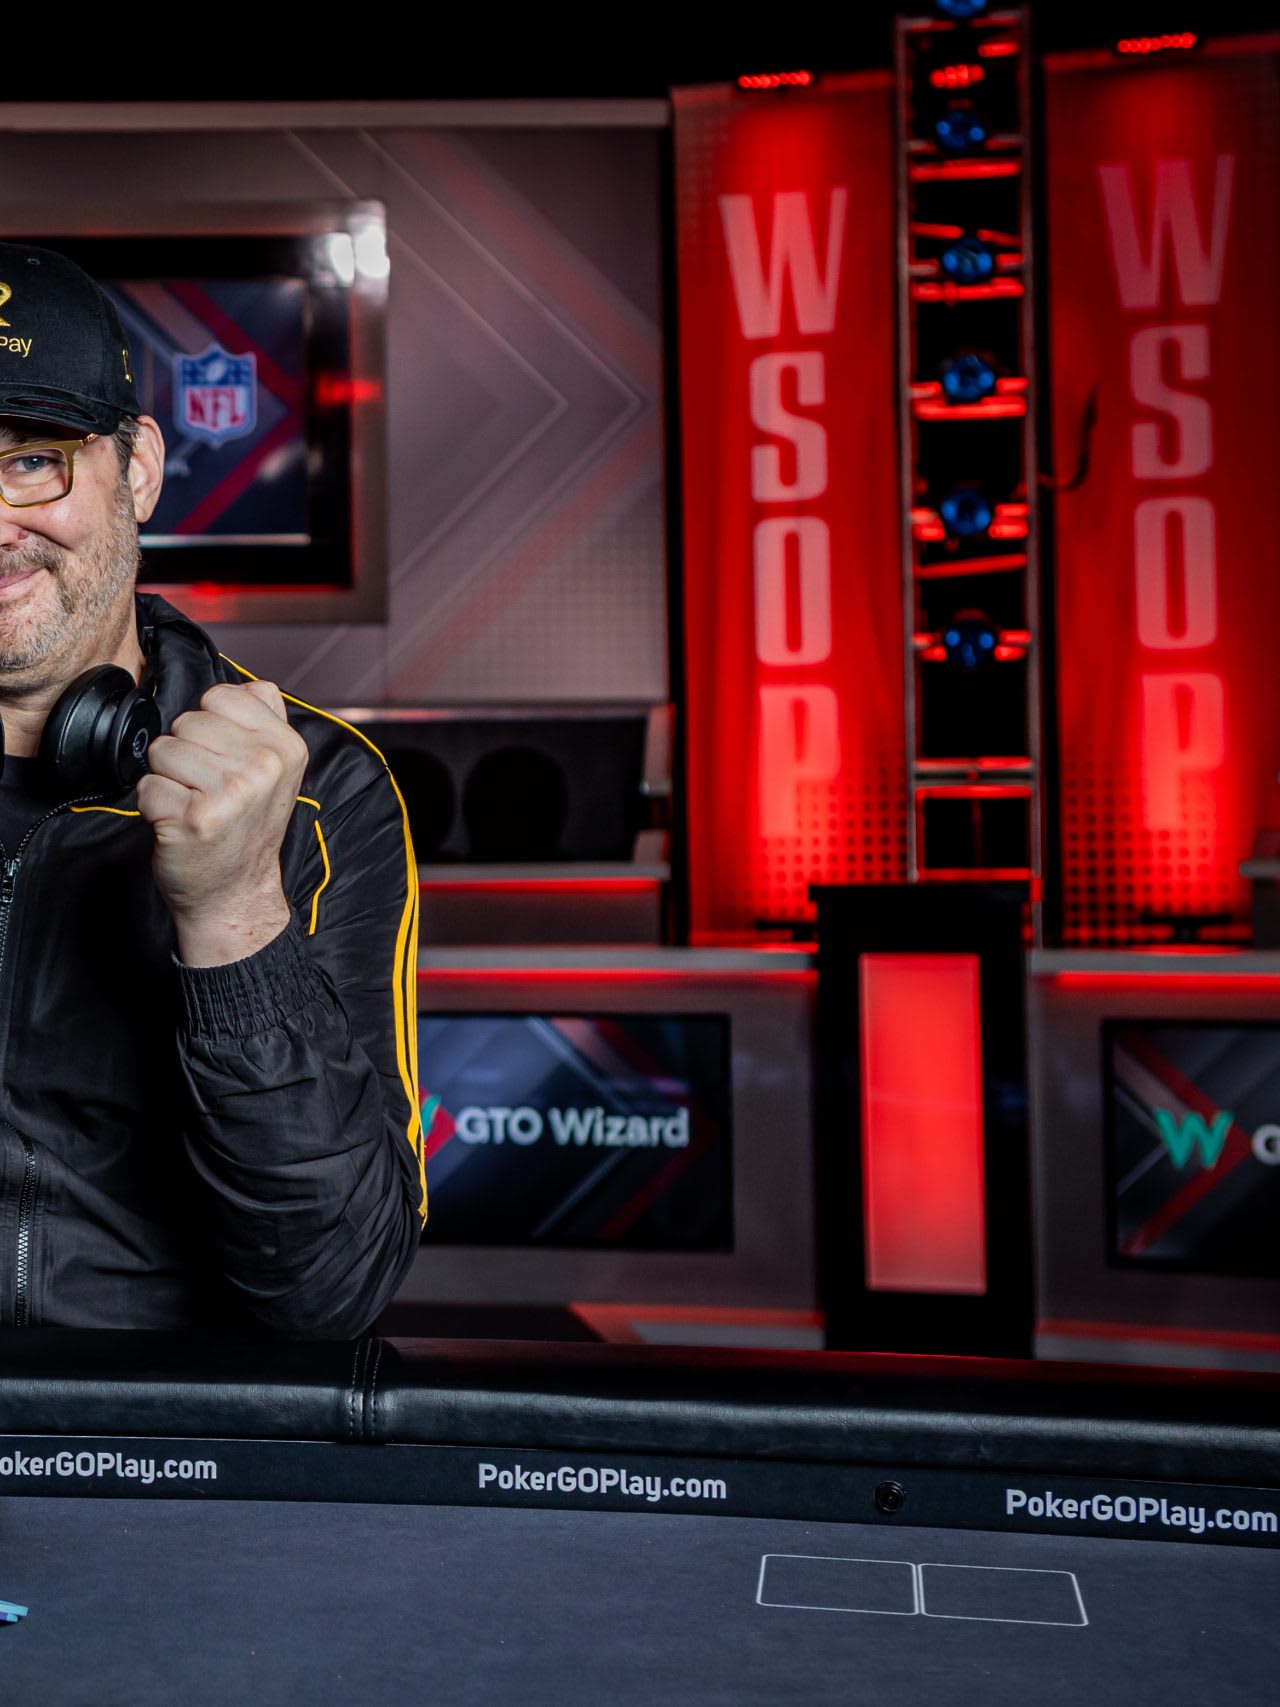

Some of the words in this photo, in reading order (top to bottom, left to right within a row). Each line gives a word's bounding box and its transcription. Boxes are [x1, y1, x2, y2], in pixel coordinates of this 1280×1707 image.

[185, 388, 249, 431] NFL
[721, 187, 848, 838] WSOP
[1099, 154, 1235, 831] WSOP
[455, 1105, 544, 1145] GTO
[547, 1105, 690, 1147] Wizard
[478, 1462, 727, 1502] PokerGOPlay.com
[1006, 1487, 1278, 1534] PokerGOPlay.com
